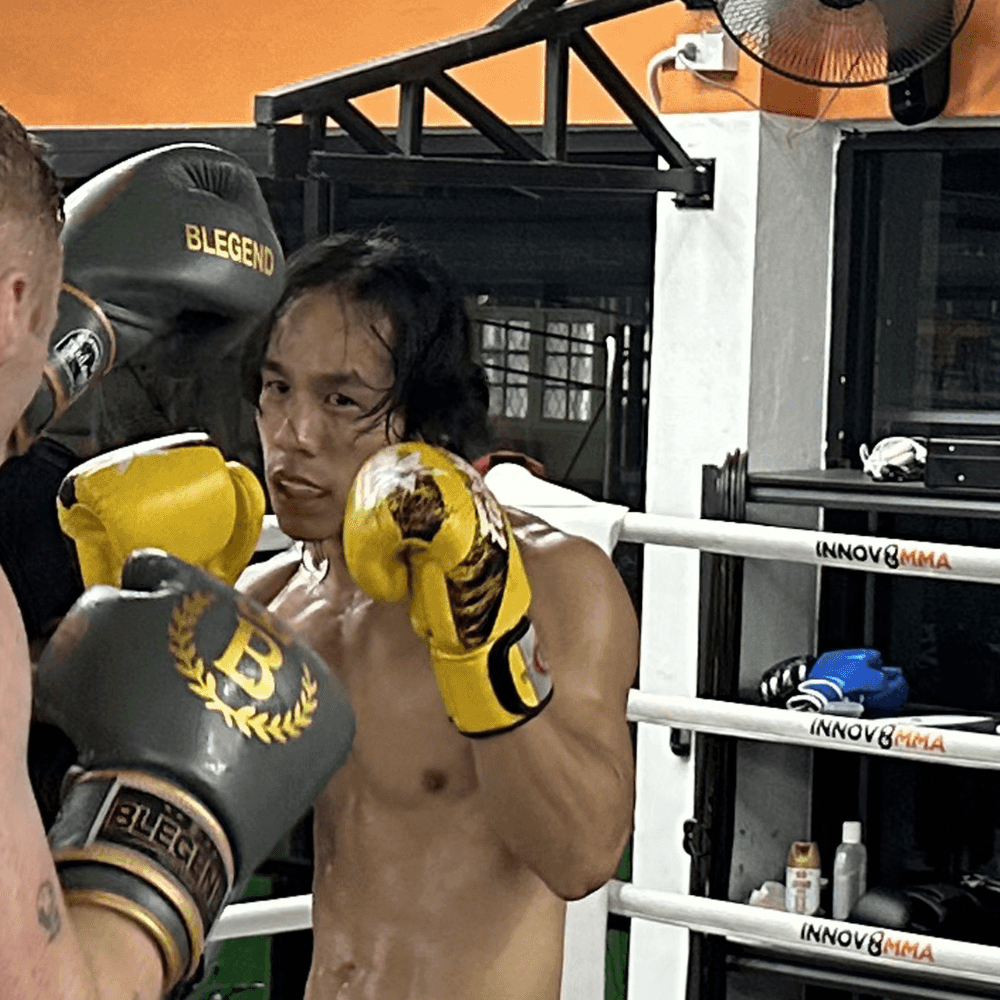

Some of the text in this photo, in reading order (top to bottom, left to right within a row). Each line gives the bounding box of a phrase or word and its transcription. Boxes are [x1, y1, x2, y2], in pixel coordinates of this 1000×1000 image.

[184, 223, 276, 277] BLEGEND
[815, 540, 952, 571] INNOV8MMA
[809, 717, 946, 753] INNOV8MMA
[799, 921, 936, 964] INNOV8MMA
